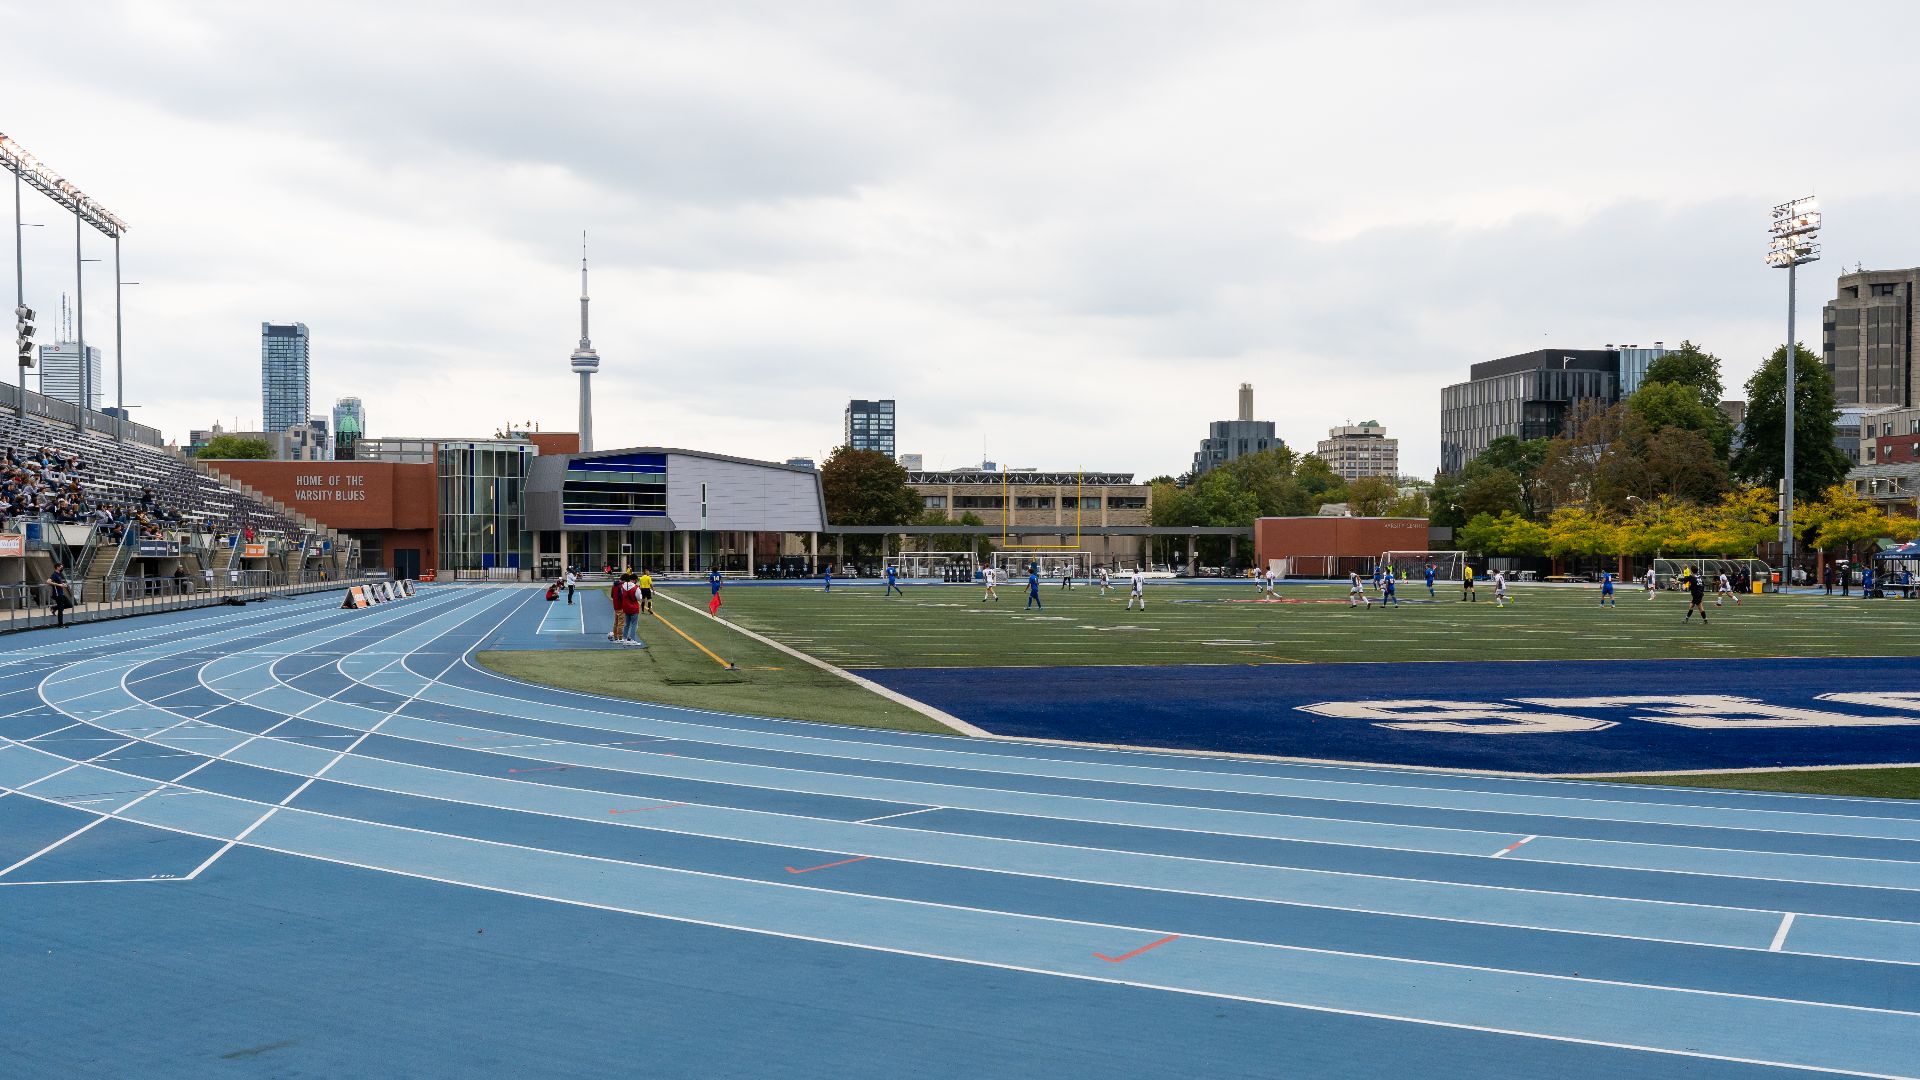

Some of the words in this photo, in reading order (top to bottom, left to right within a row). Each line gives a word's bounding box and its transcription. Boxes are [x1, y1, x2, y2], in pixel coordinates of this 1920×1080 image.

[296, 475, 323, 486] HOME
[328, 475, 341, 486] OF
[345, 475, 364, 486] THE
[295, 489, 333, 501] VARSITY
[335, 490, 365, 501] BLUES
[1292, 691, 1920, 735] ES
